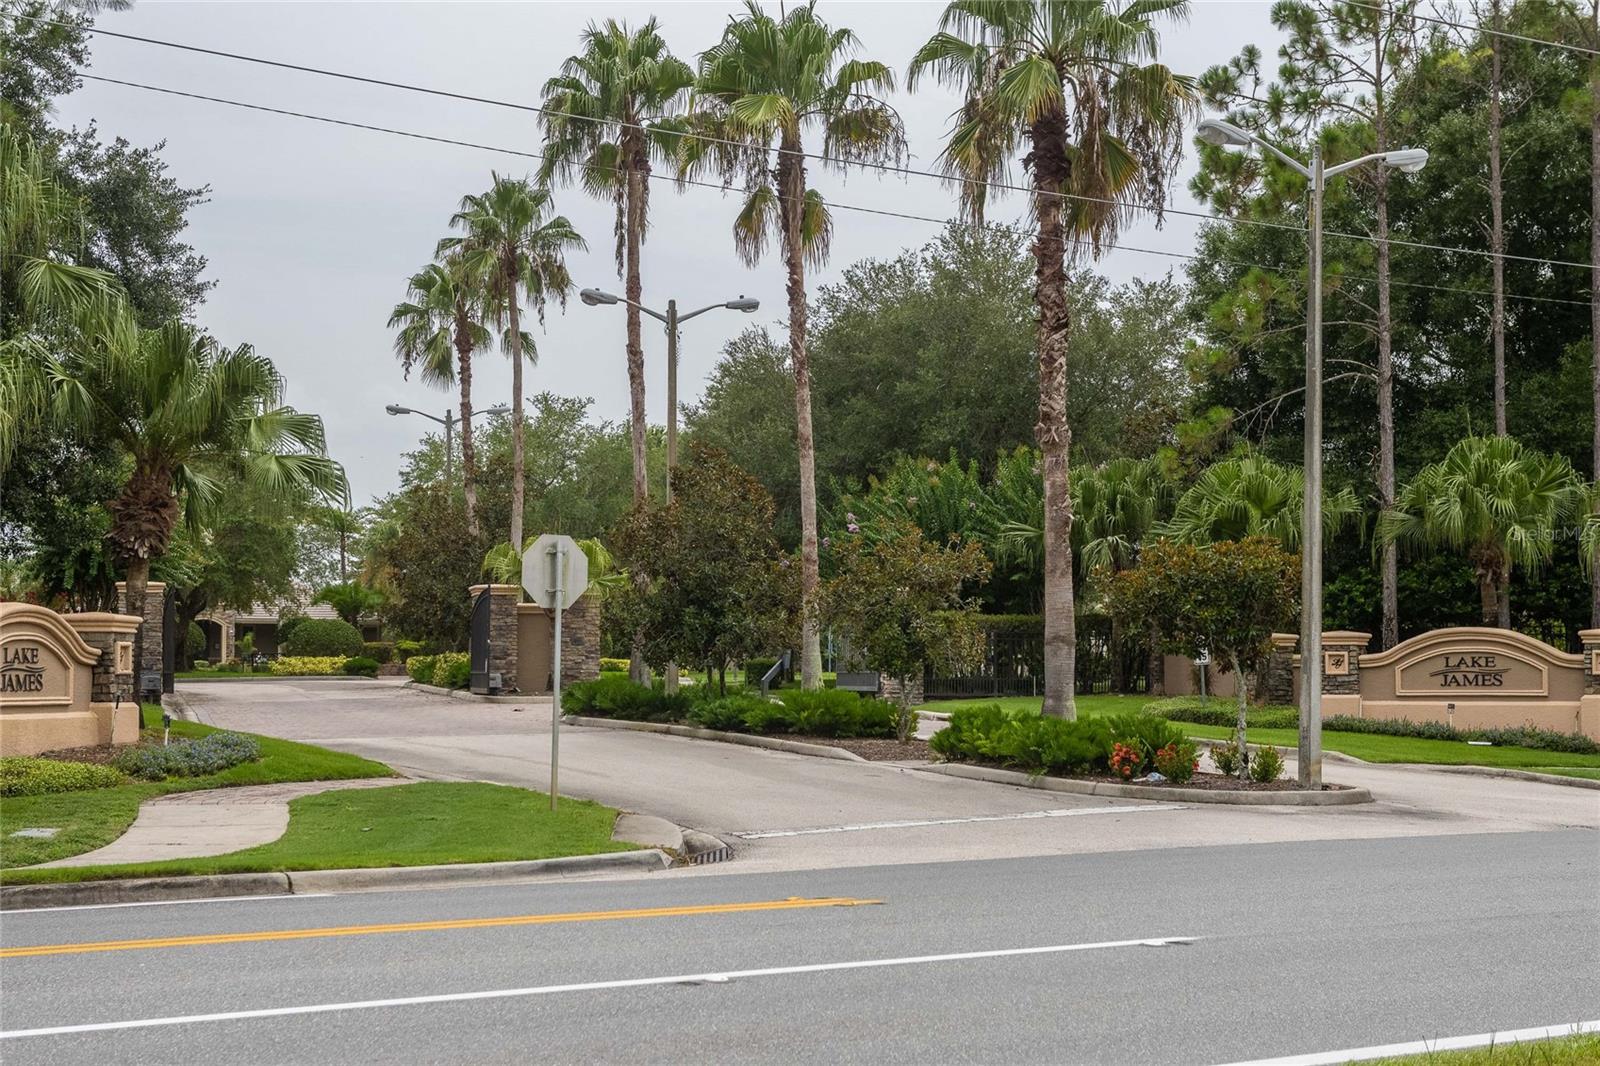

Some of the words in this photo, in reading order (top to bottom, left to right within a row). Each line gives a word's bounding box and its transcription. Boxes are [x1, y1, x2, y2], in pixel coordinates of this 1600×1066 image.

[3, 648, 39, 664] LAKE
[1444, 656, 1496, 668] LAKE
[0, 674, 43, 692] JAMES
[1440, 674, 1503, 687] JAMES
